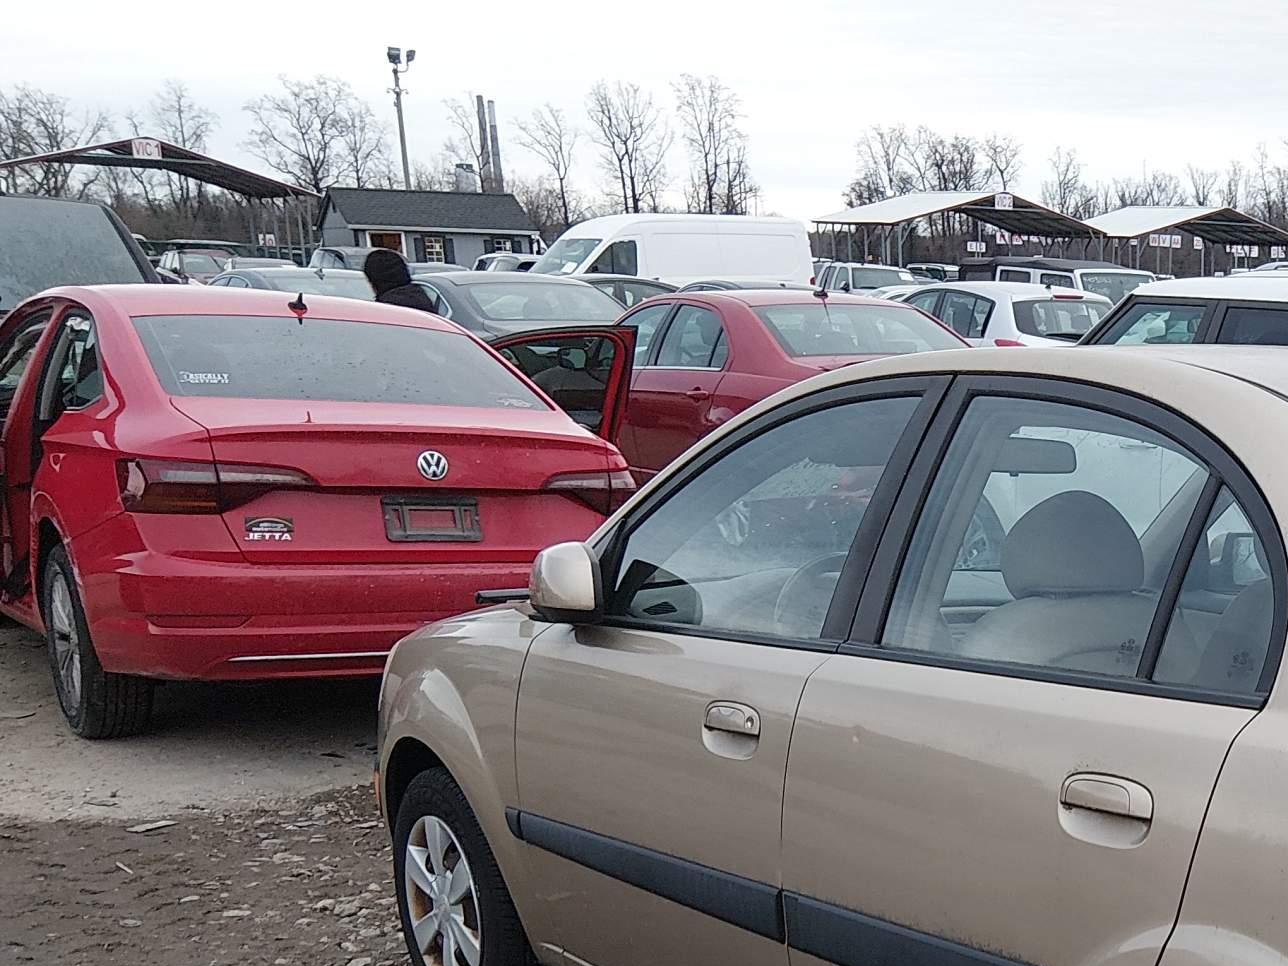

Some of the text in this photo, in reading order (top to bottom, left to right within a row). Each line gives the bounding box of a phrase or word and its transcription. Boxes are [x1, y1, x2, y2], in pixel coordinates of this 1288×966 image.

[133, 141, 161, 157] VIC 1
[244, 532, 292, 541] JETTA
